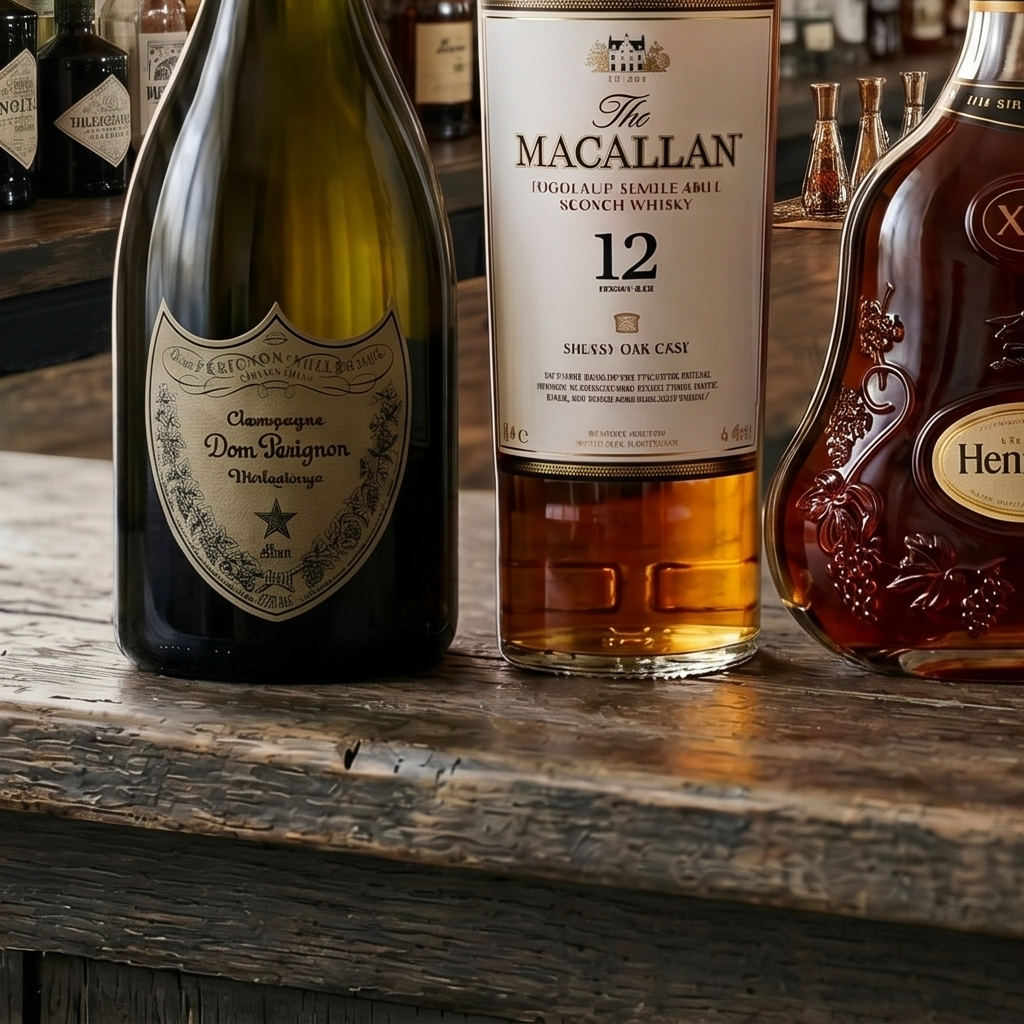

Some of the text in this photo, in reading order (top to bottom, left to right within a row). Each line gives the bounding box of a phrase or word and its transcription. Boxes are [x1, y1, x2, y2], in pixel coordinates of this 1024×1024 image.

[515, 132, 742, 170] MACALLAN
[630, 198, 693, 212] WHISKY
[595, 232, 658, 280] 12
[620, 342, 651, 355] OAK
[204, 432, 259, 459] Dom
